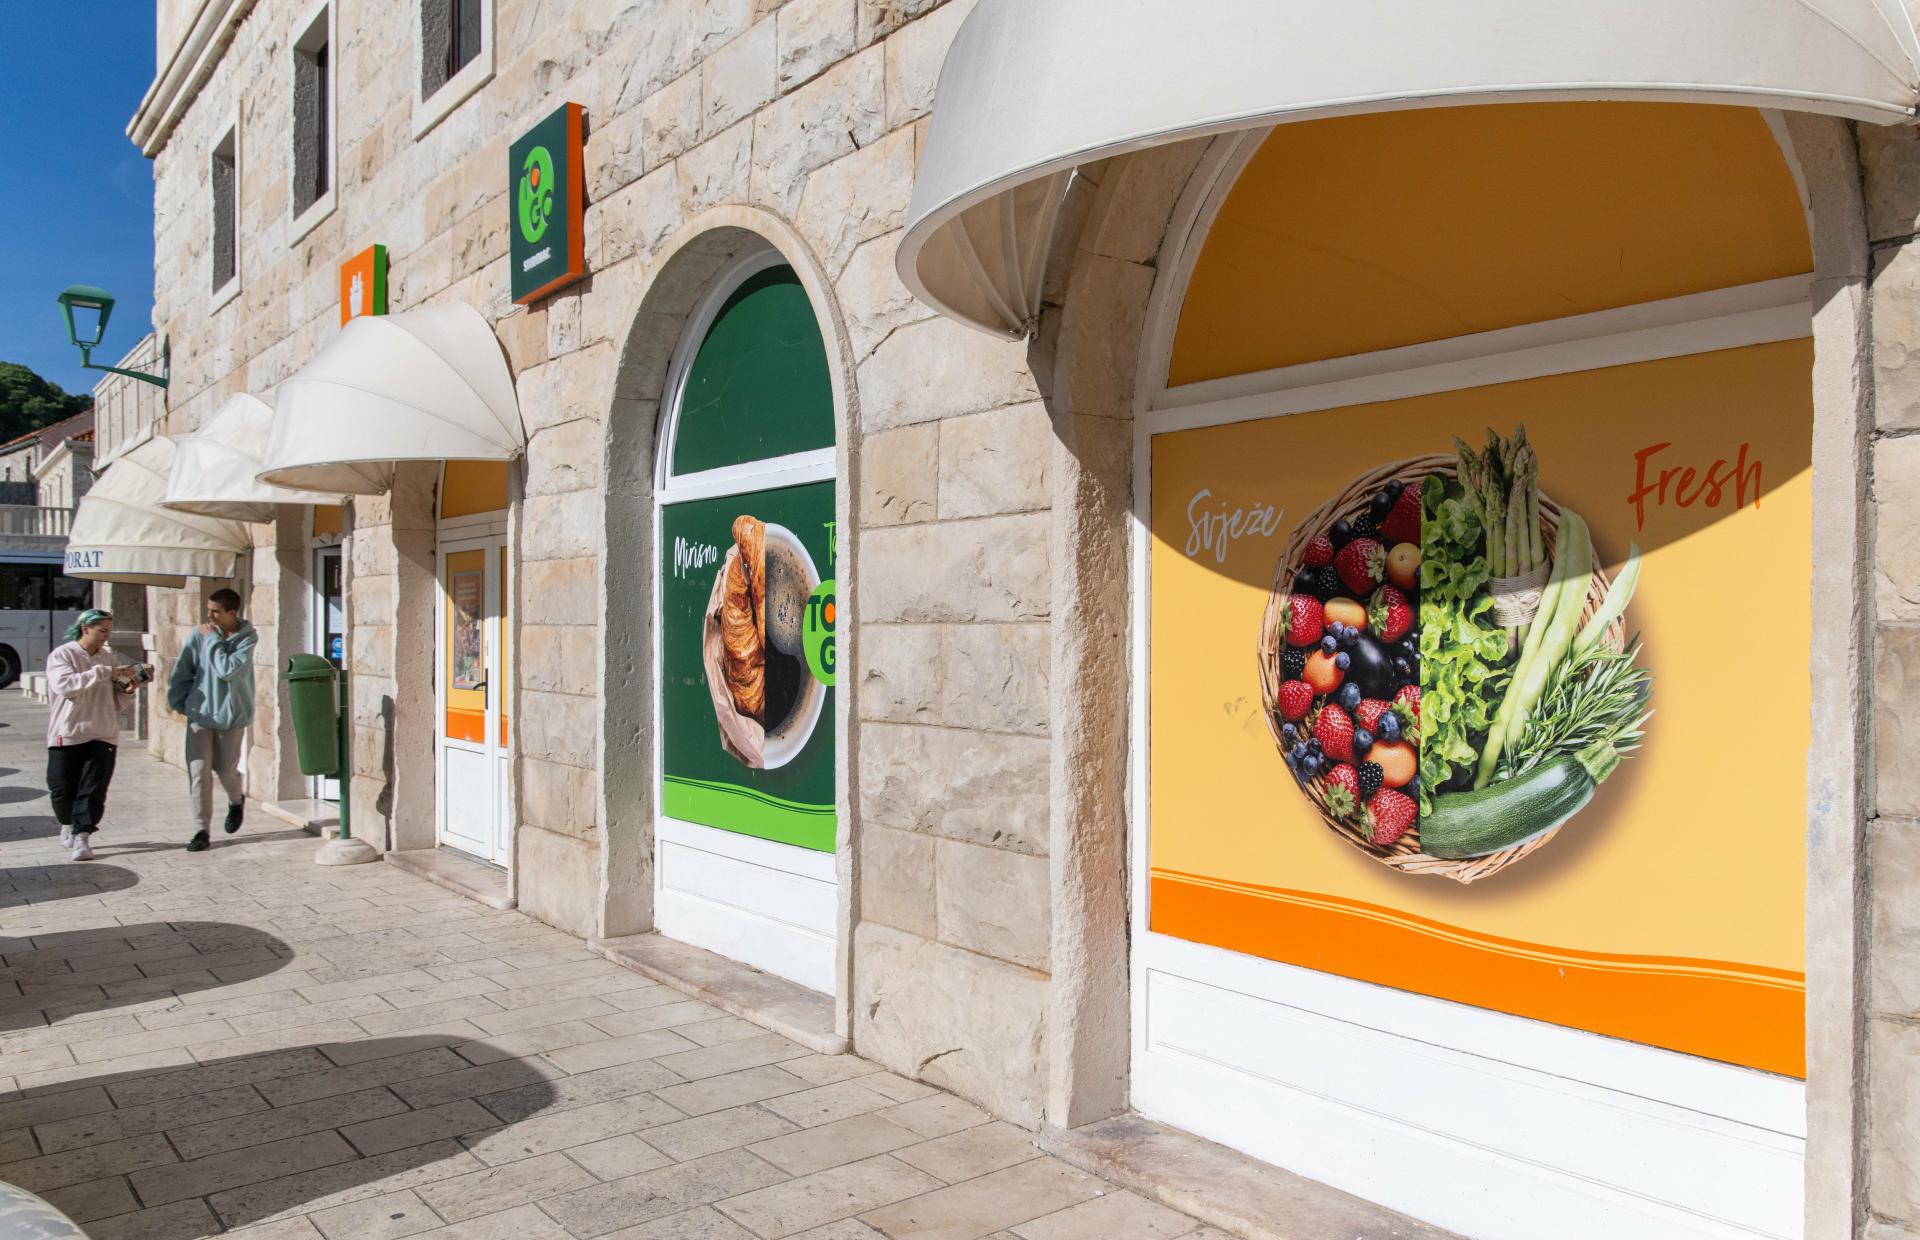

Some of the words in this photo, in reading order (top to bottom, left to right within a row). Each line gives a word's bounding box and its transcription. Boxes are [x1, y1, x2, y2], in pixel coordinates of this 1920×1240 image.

[1627, 442, 1762, 532] Fresh
[674, 536, 717, 579] Mirisno
[1185, 489, 1285, 563] Svježe
